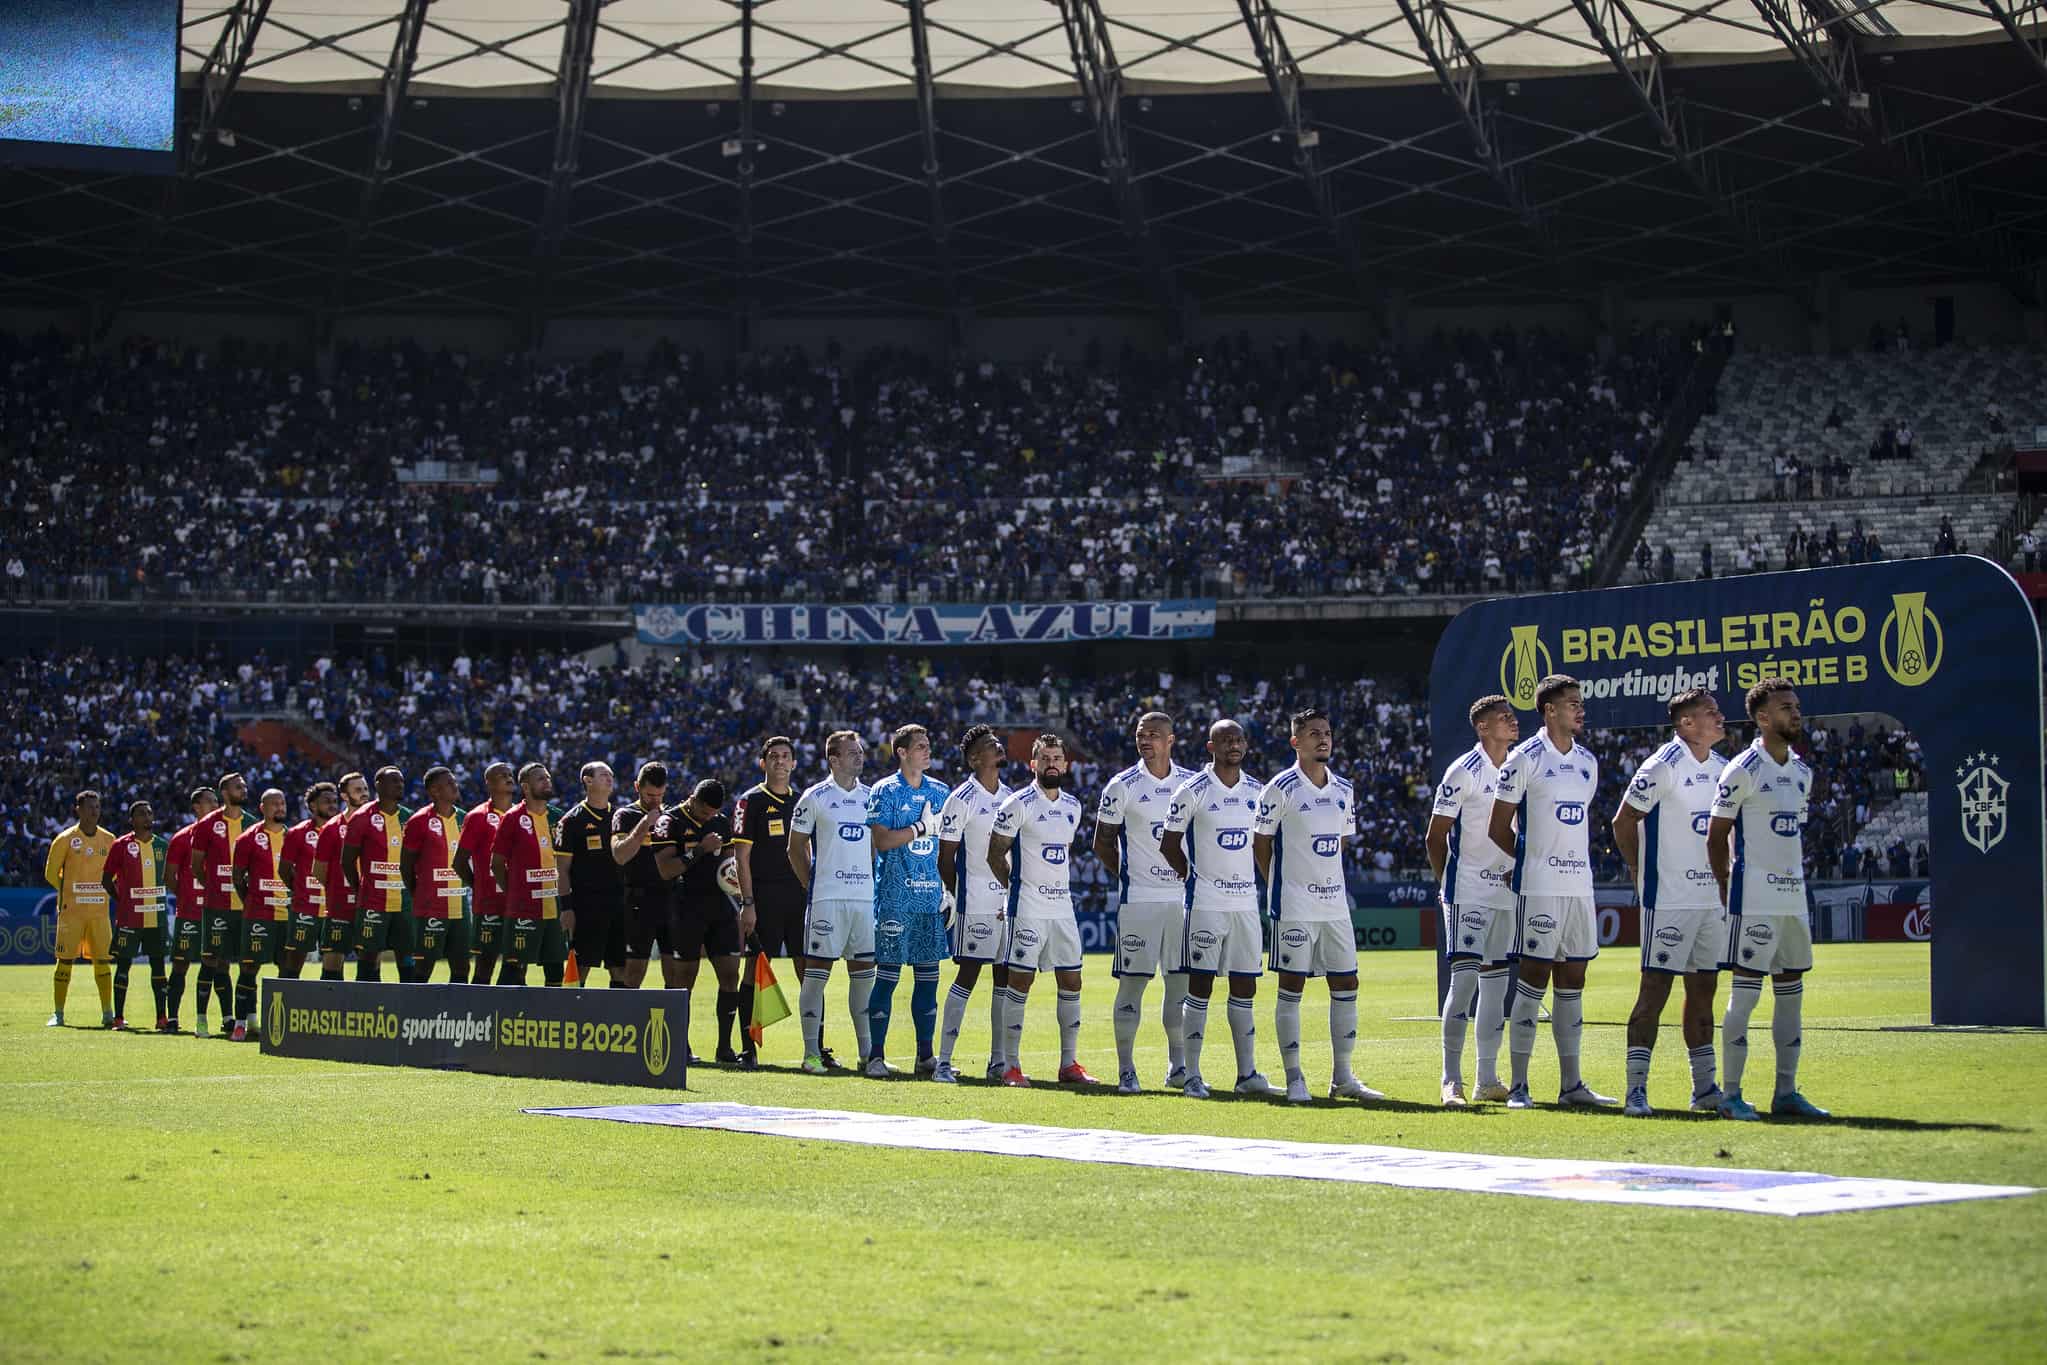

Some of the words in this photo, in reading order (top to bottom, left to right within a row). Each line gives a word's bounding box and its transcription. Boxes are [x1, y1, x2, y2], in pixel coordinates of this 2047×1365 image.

[686, 604, 948, 645] CHINA
[965, 601, 1173, 643] AZUL
[1562, 598, 1866, 663] BRASILEIRÃO
[1578, 664, 1719, 702] portingbet
[1737, 654, 1840, 690] SÉRIE
[1846, 655, 1868, 683] B
[1974, 801, 1993, 812] CBF
[1560, 808, 1582, 820] BH
[1775, 818, 1798, 832] BH
[842, 827, 862, 838] BH
[912, 840, 931, 850] BH
[1221, 834, 1245, 846] BH
[1316, 840, 1338, 852] BH
[1046, 849, 1065, 860] BH
[289, 1005, 398, 1039] BRASILEIRÃO
[401, 1011, 492, 1047] sportingbet
[501, 1011, 560, 1049] SÉRIE
[564, 1021, 578, 1050] B
[582, 1022, 637, 1054] 2022
